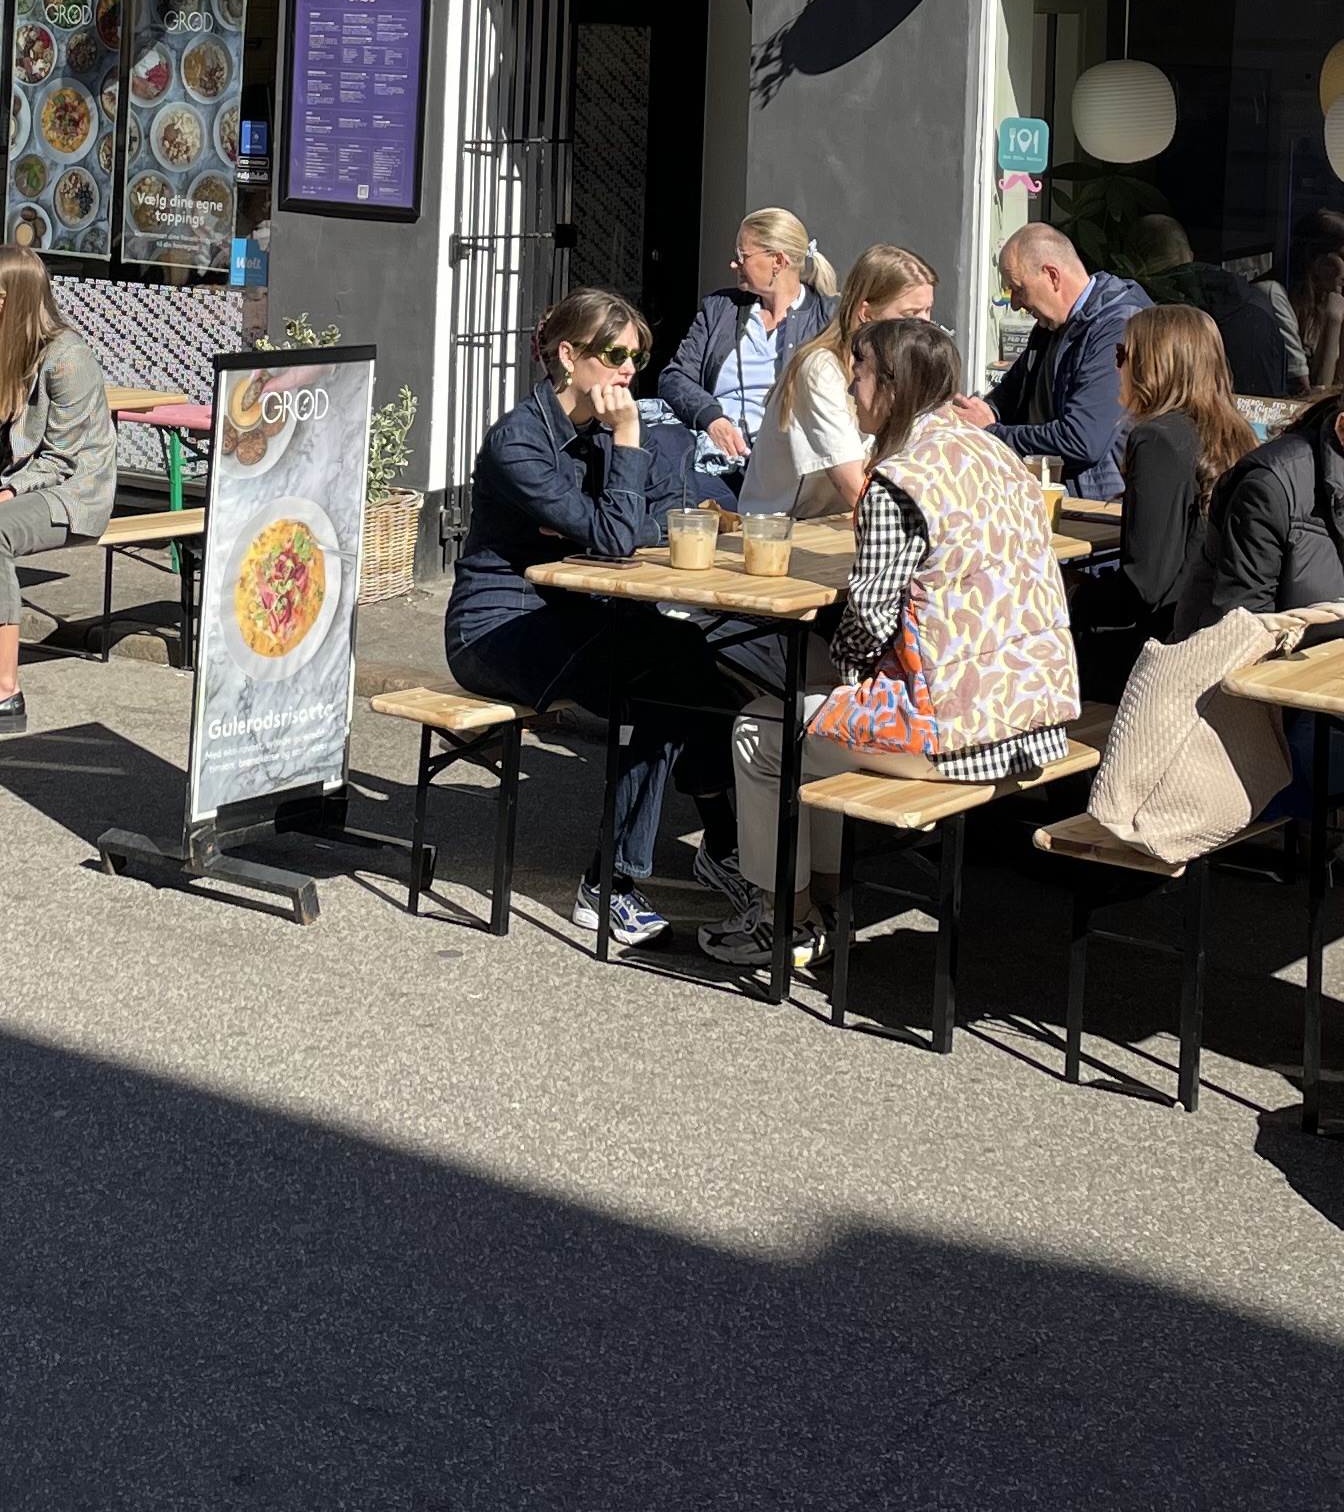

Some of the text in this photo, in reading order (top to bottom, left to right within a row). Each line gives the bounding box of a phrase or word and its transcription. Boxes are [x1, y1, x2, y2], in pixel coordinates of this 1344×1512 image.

[137, 192, 223, 213] Vælg dine egne
[155, 211, 205, 228] toppings
[236, 256, 262, 270] Wolt
